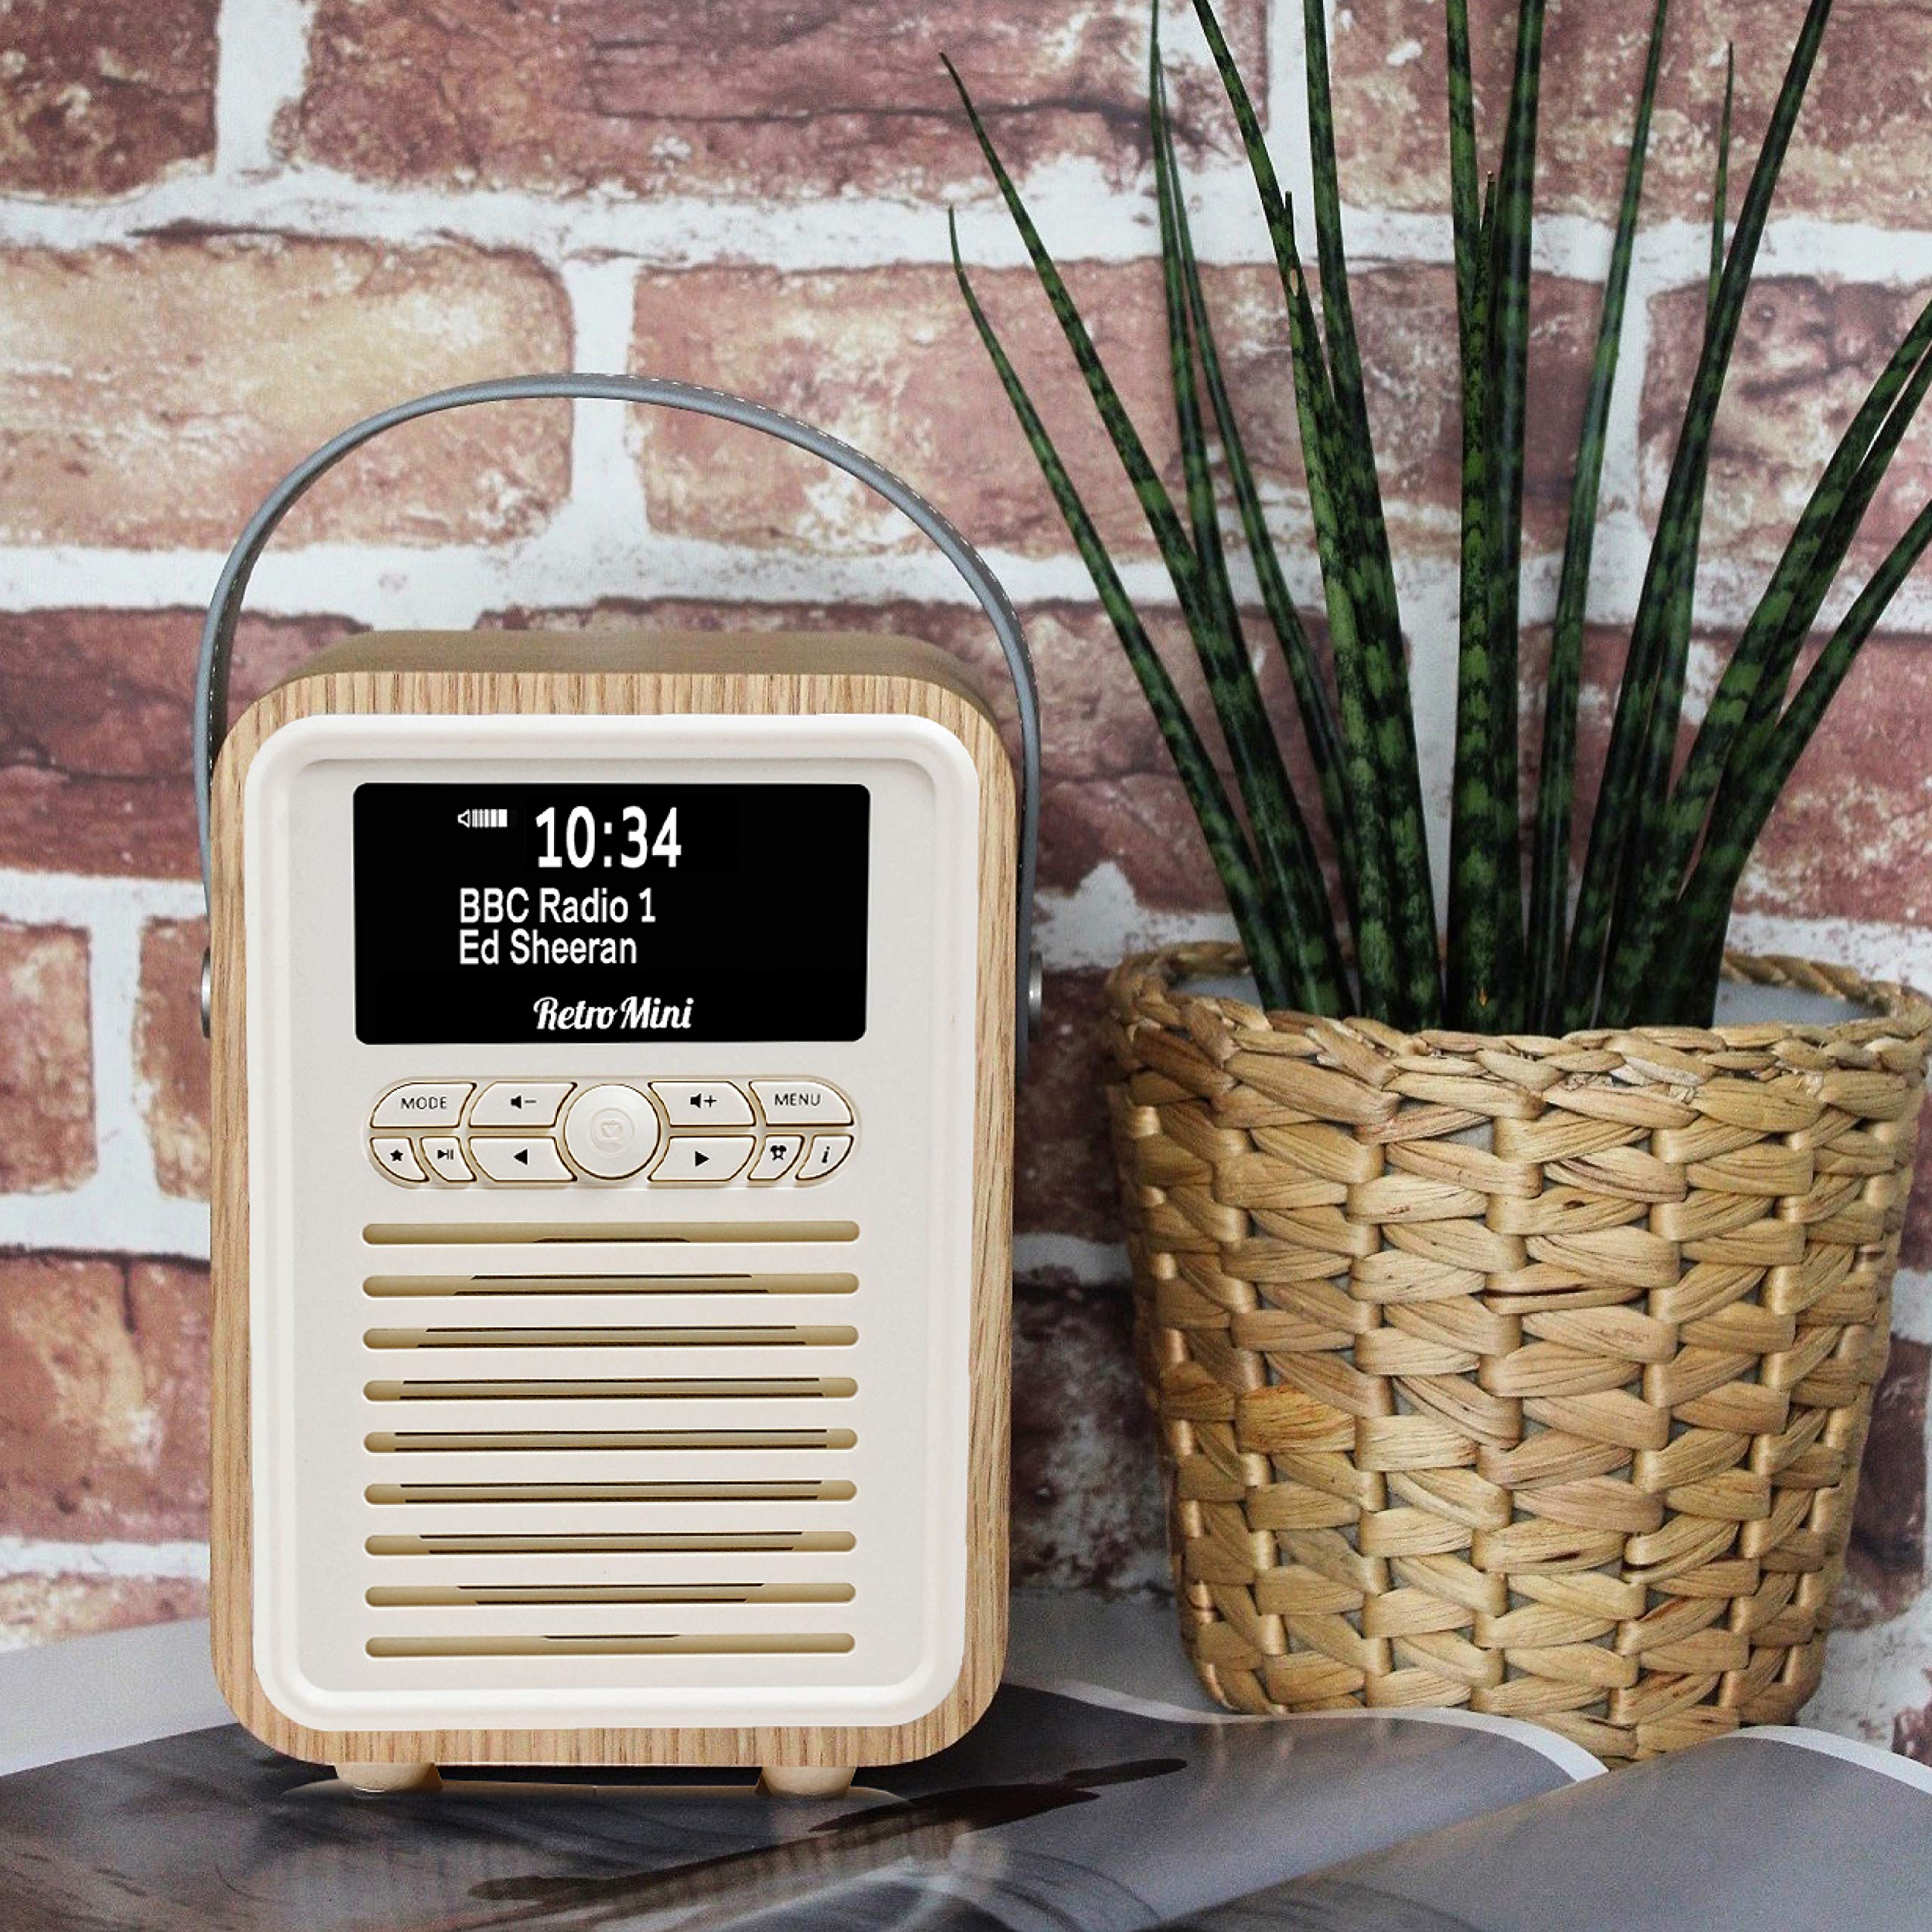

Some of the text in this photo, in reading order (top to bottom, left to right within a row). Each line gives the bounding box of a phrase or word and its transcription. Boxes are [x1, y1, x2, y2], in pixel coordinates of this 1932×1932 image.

[536, 805, 682, 869] 10:34
[460, 887, 657, 923] BBC Radio 1
[460, 928, 637, 965] Ed Sheeran
[533, 995, 694, 1031] Retro Mini
[401, 1096, 447, 1109] MODE
[774, 1093, 821, 1106] MENU
